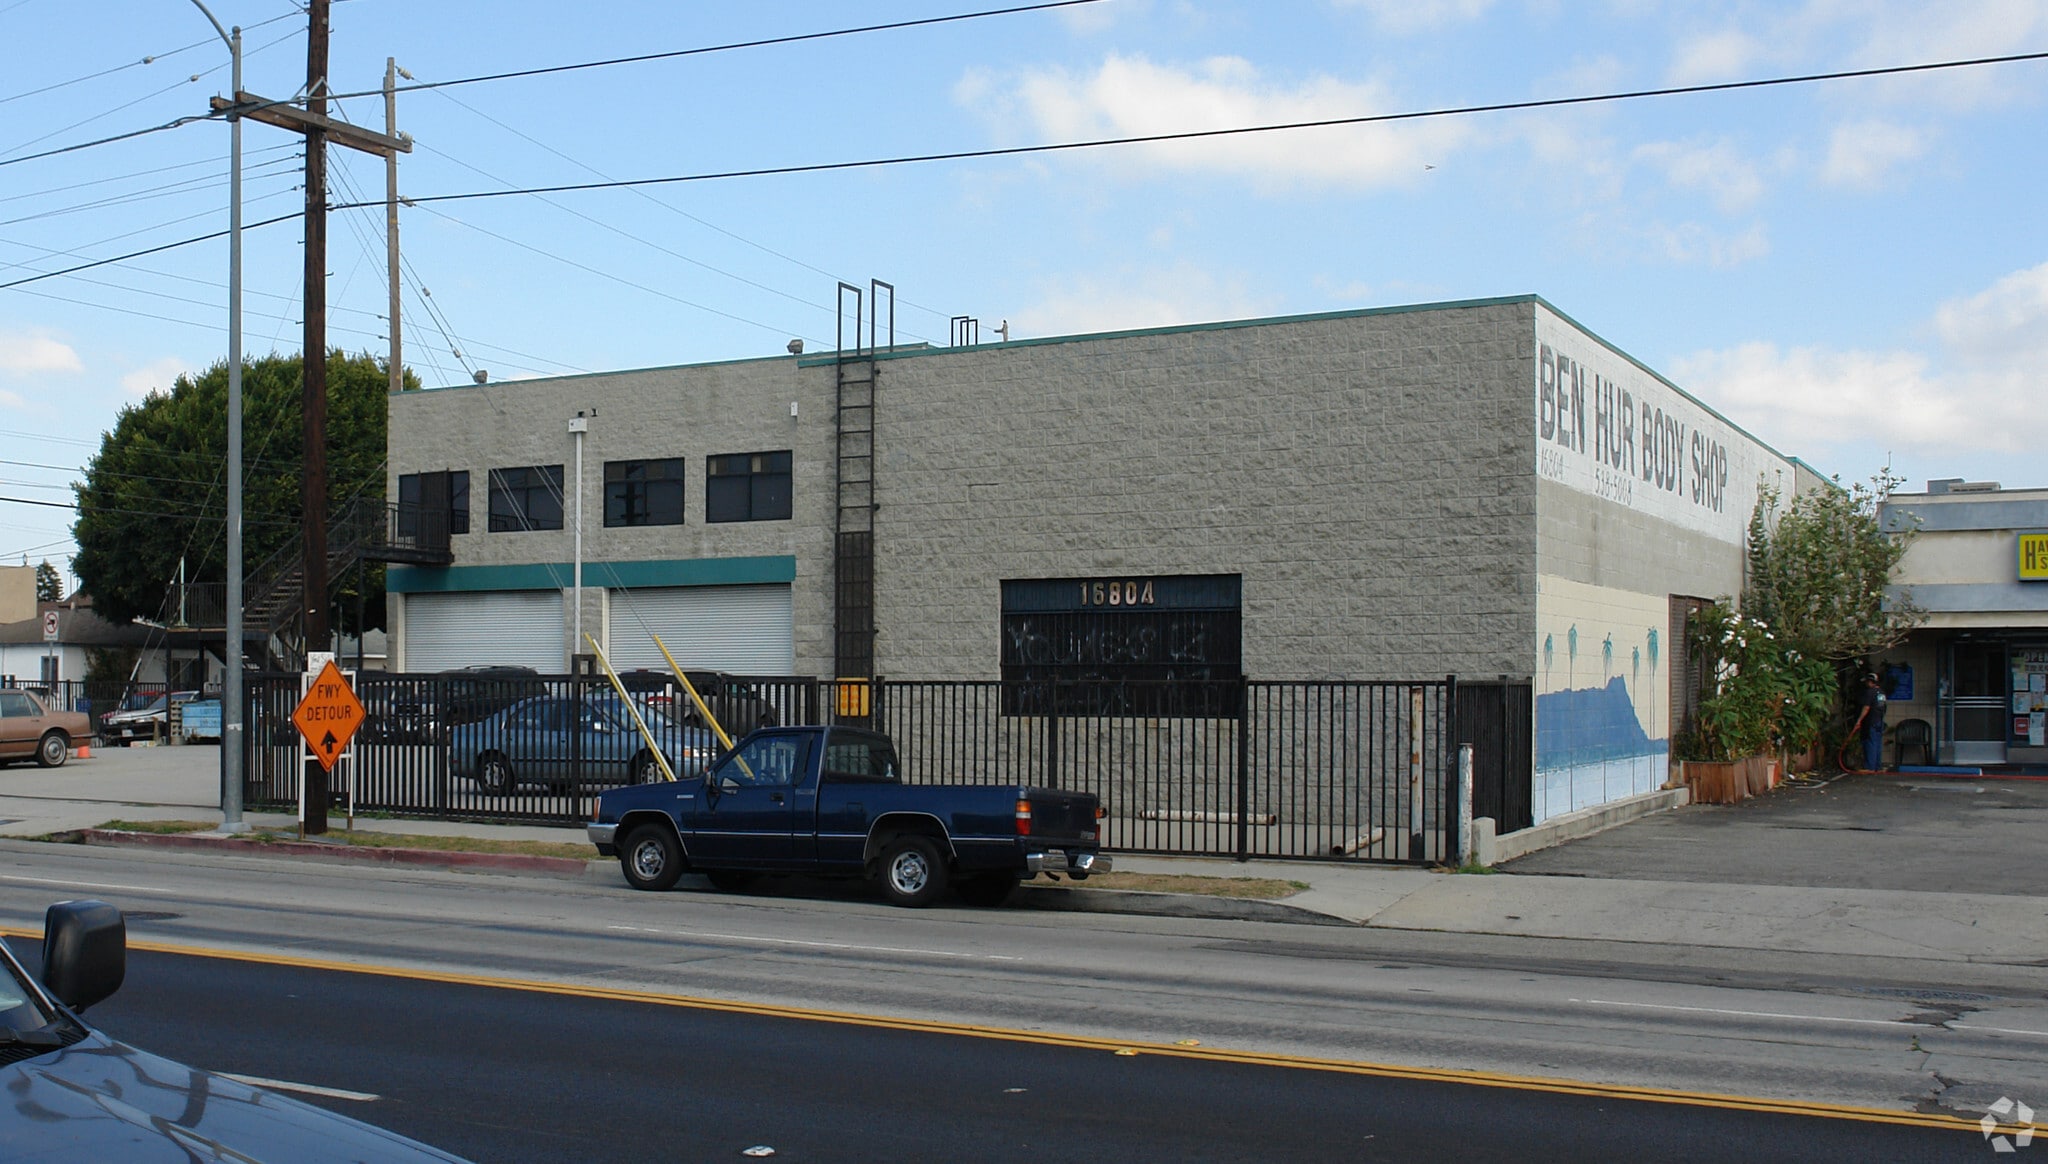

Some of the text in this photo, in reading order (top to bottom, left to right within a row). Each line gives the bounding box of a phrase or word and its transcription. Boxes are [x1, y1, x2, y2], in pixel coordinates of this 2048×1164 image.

[1540, 343, 1727, 514] BEN HUR BODY SHOP
[1080, 580, 1154, 606] 16804
[317, 684, 341, 699] FWY
[307, 704, 352, 721] DETOUR
